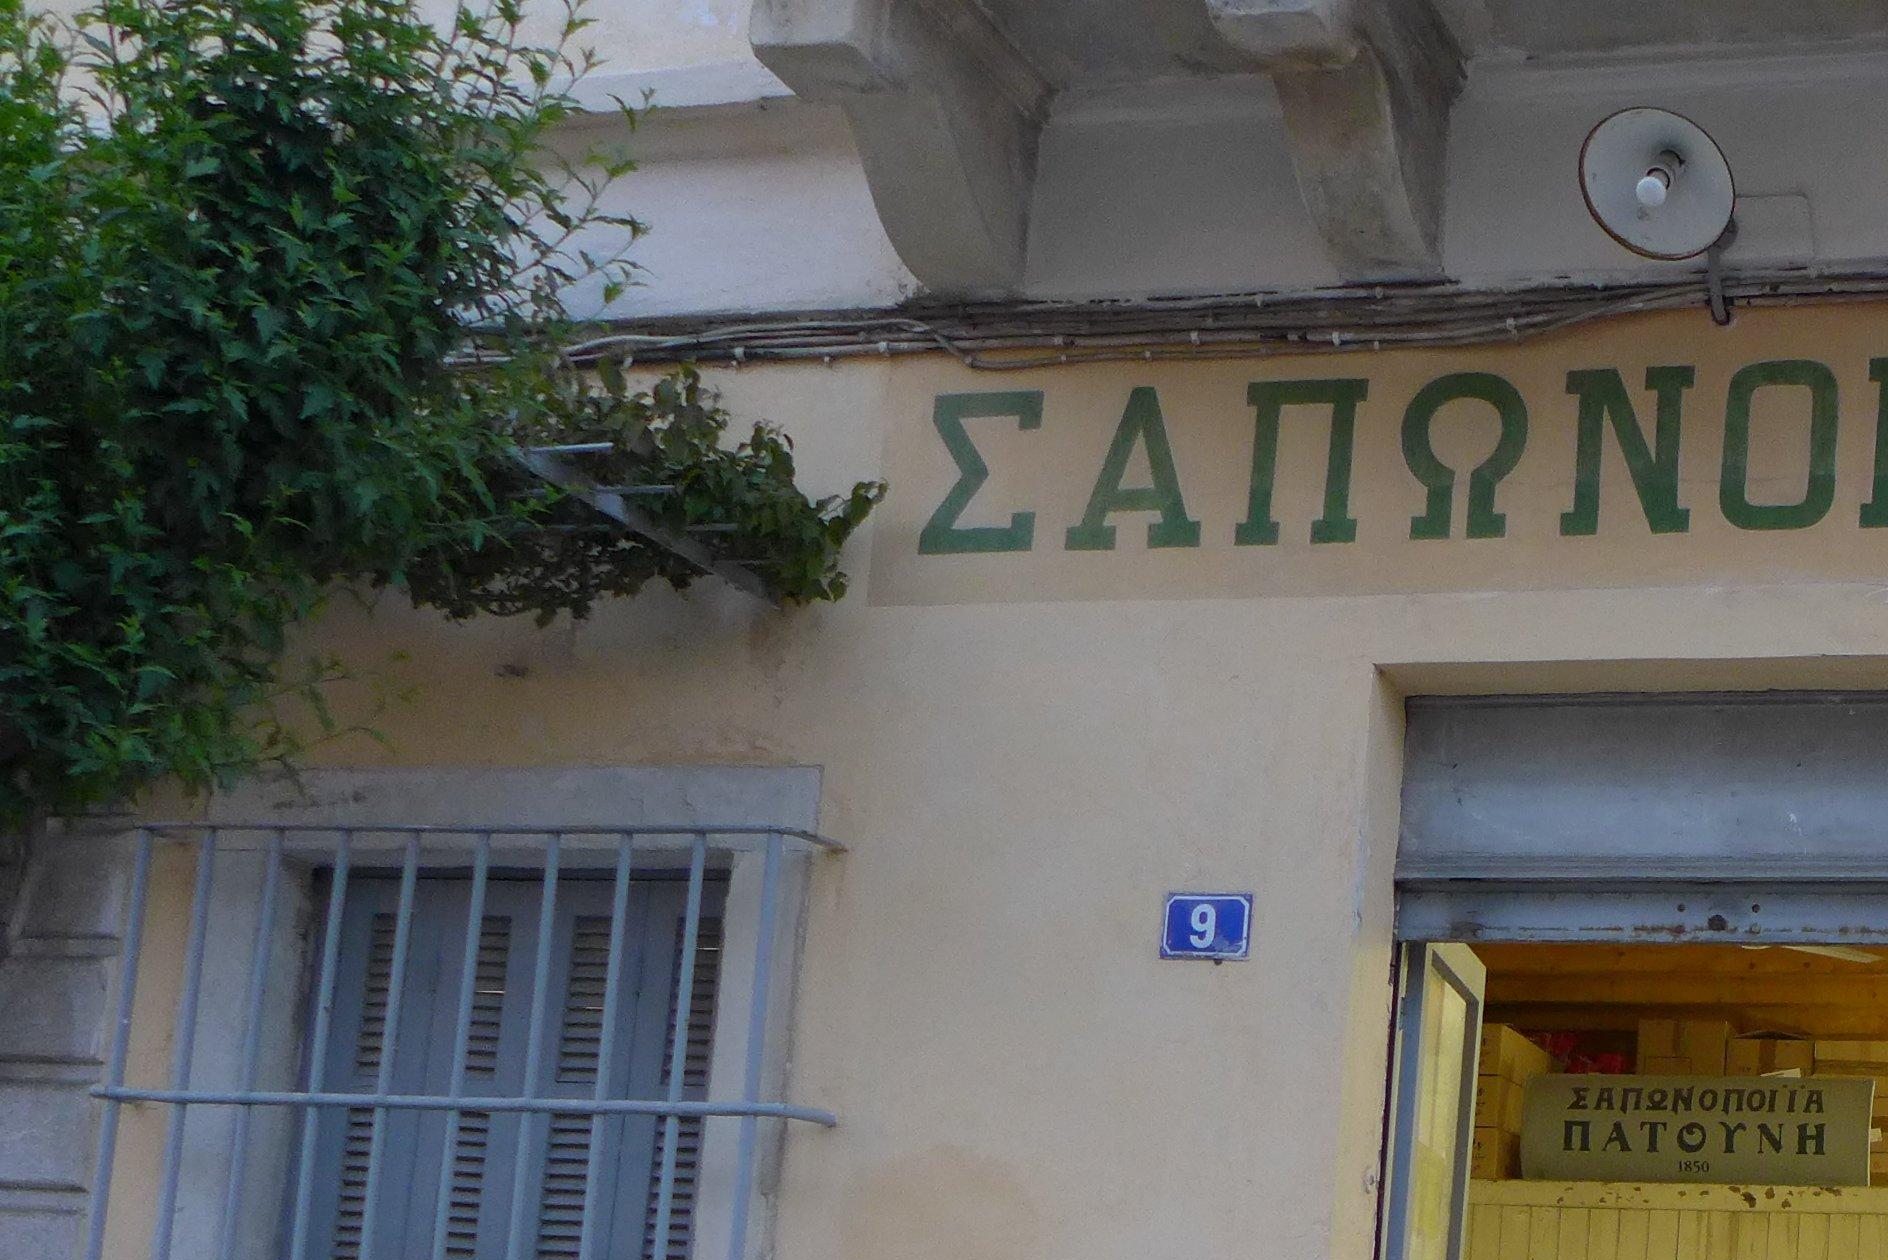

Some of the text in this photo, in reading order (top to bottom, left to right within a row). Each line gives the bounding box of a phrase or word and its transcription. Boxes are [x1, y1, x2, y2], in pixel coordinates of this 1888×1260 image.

[1189, 903, 1217, 949] 9
[1562, 1120, 1826, 1155] ΠΑΤΟΥΝΗ
[1677, 1160, 1710, 1174] 1850
